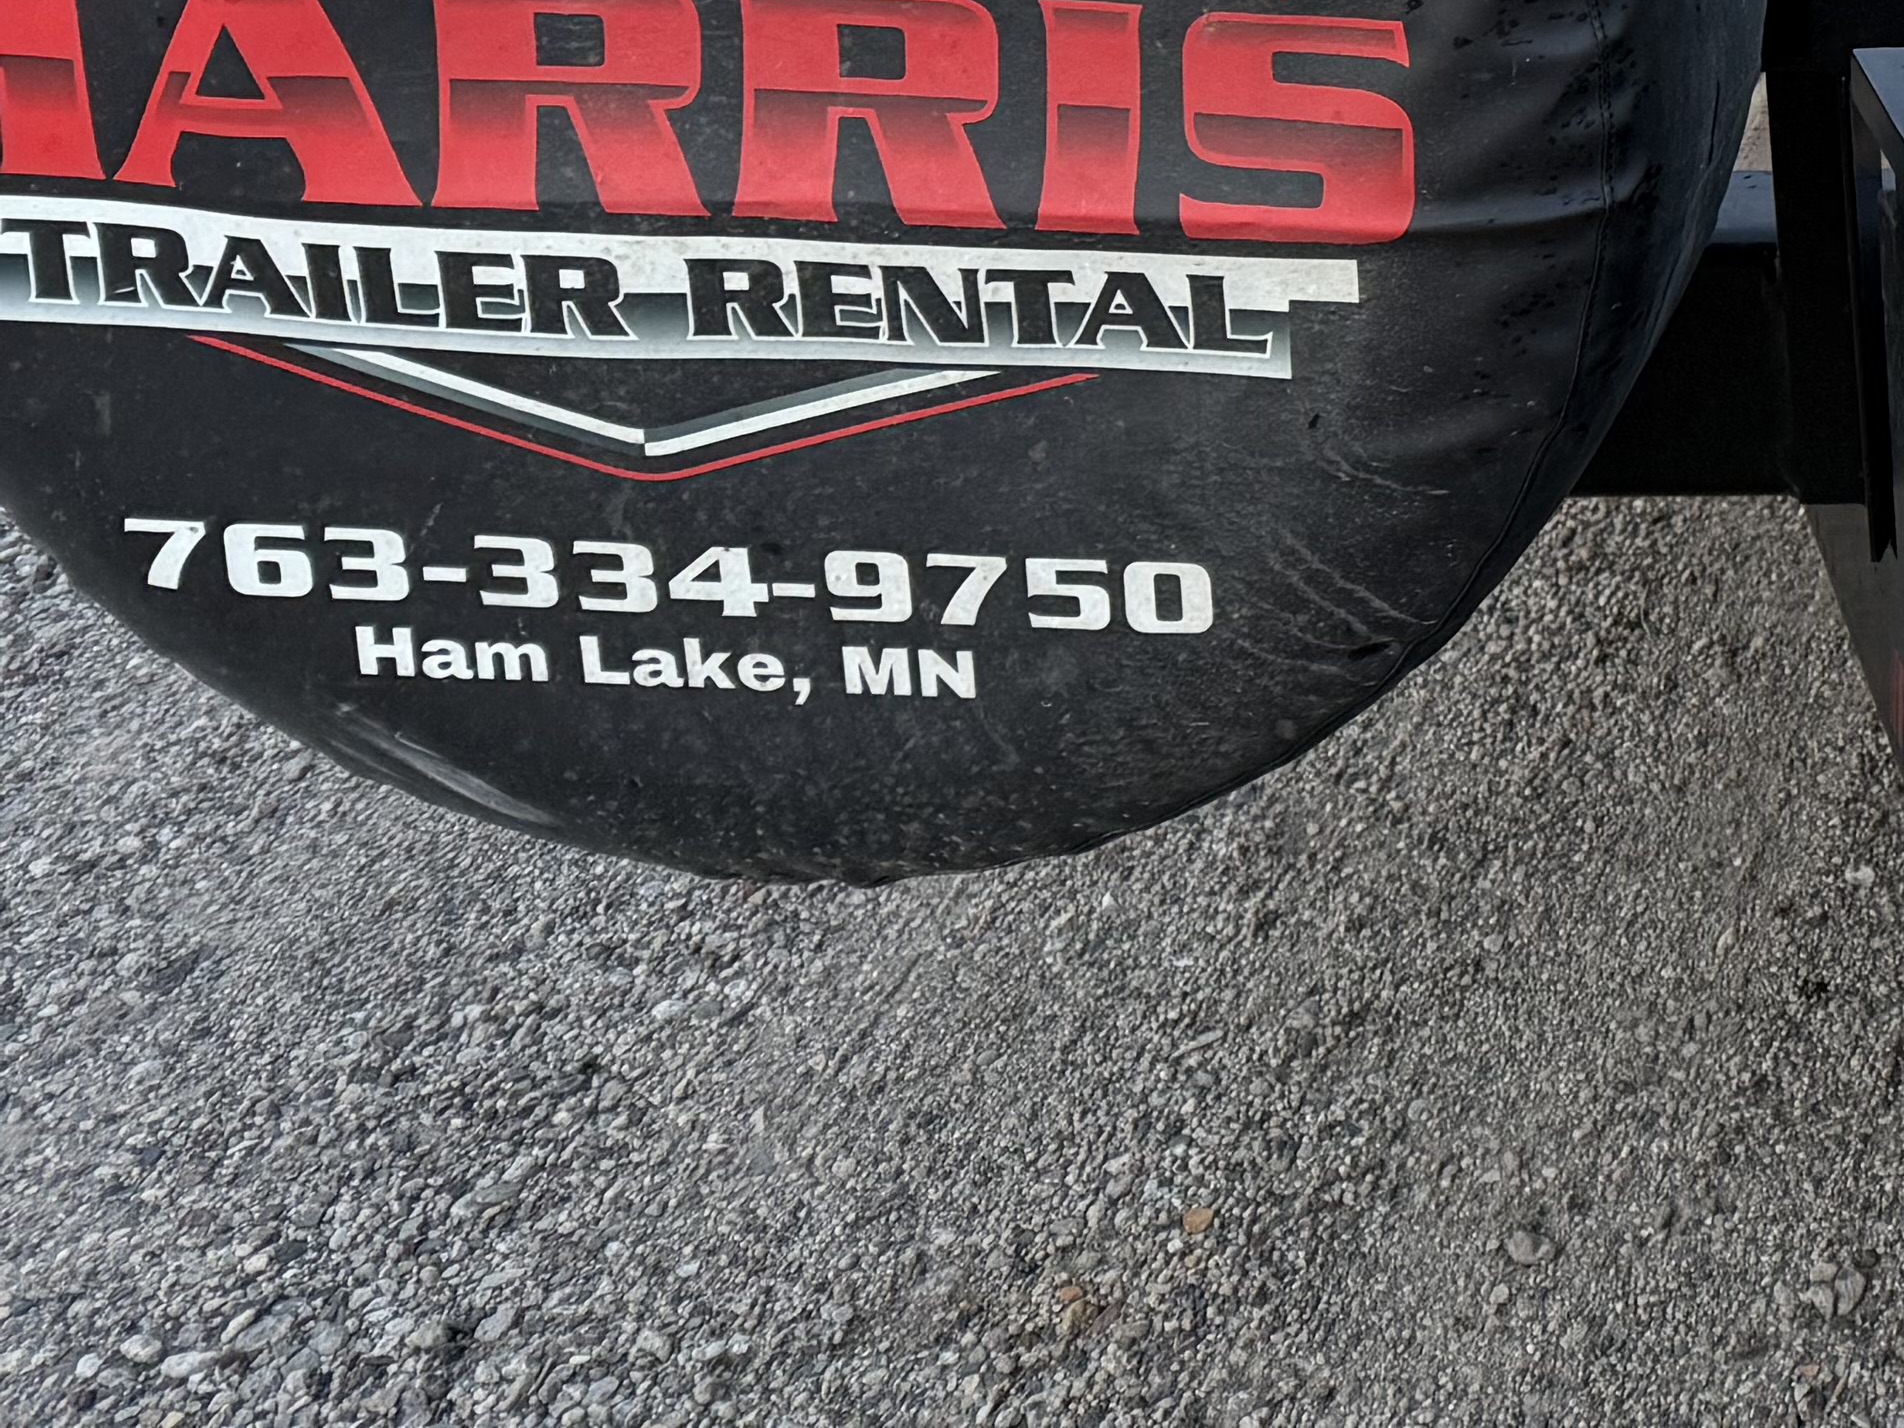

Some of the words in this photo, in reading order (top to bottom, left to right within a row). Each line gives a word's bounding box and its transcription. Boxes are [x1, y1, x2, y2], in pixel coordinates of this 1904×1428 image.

[0, 218, 636, 342] TRAILER
[685, 257, 1272, 356] RENTAL
[123, 517, 1216, 635] 763-334-9750
[354, 625, 549, 683] Ham
[580, 634, 812, 706] Lake,
[843, 645, 976, 700] MN
